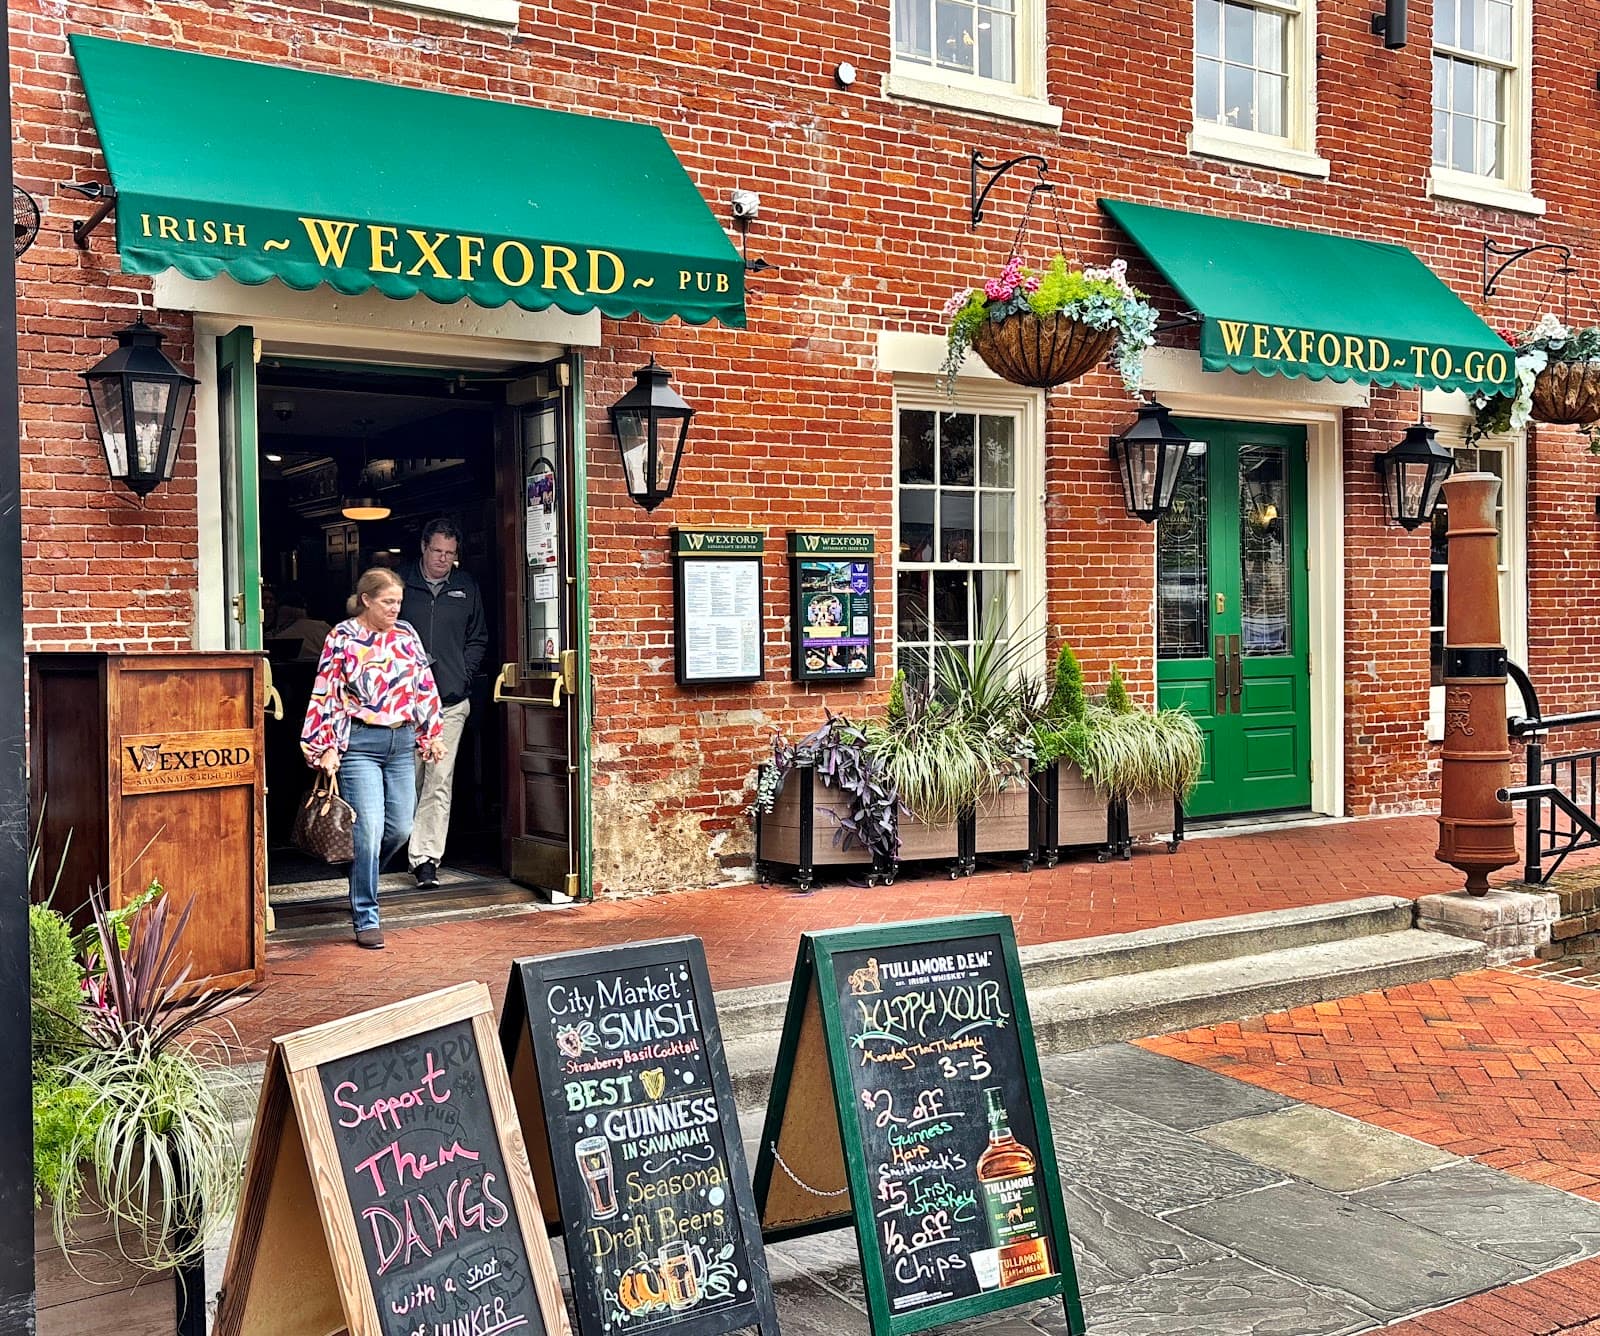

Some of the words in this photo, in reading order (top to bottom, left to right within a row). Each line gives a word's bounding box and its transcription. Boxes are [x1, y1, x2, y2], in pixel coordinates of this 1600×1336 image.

[140, 214, 247, 246] IRISH
[298, 217, 625, 295] WEXFORD
[679, 270, 729, 293] PUB
[1217, 320, 1390, 372] WEXFORD
[1410, 346, 1507, 384] TO-GO
[705, 535, 758, 544] WEXFORD
[820, 537, 870, 546] WEXFORD
[126, 743, 250, 772] WEXFORD
[136, 774, 195, 786] SAVANNAH'S
[197, 773, 220, 781] IRISH
[224, 771, 242, 780] PUB
[879, 958, 955, 980] TULLAMORE
[908, 976, 930, 986] IRISH
[931, 971, 966, 983] WHISKEY
[547, 985, 595, 1017] City
[596, 972, 681, 1009] Market
[600, 1000, 700, 1050] SMASH
[623, 1047, 654, 1063] Basil
[653, 1038, 700, 1060] Cocktail
[861, 1045, 916, 1070] Monday
[933, 1034, 988, 1056] Thursday
[938, 1054, 993, 1081] 3-5
[333, 1052, 450, 1130] Support
[564, 1075, 634, 1112] BEST
[861, 1087, 908, 1128] $2
[912, 1088, 944, 1118] off
[603, 1097, 719, 1142] GUINNESS
[887, 1121, 953, 1148] Guinness
[622, 1142, 638, 1160] IN
[639, 1126, 710, 1158] SAVANNAH
[892, 1144, 930, 1165] Harp
[354, 1141, 480, 1197] Them
[626, 1156, 729, 1203] Seasonal
[878, 1148, 967, 1180] Smithwick's
[877, 1181, 908, 1210] $5
[908, 1175, 956, 1203] Irish
[984, 1175, 1034, 1195] TULLAMORE
[361, 1173, 509, 1276] DAWGS
[587, 1213, 655, 1257] Draft
[655, 1206, 725, 1241] Beers
[911, 1209, 951, 1247] off
[391, 1283, 436, 1315] with
[445, 1278, 457, 1292] a
[466, 1256, 498, 1285] shot
[895, 1253, 967, 1284] Chips
